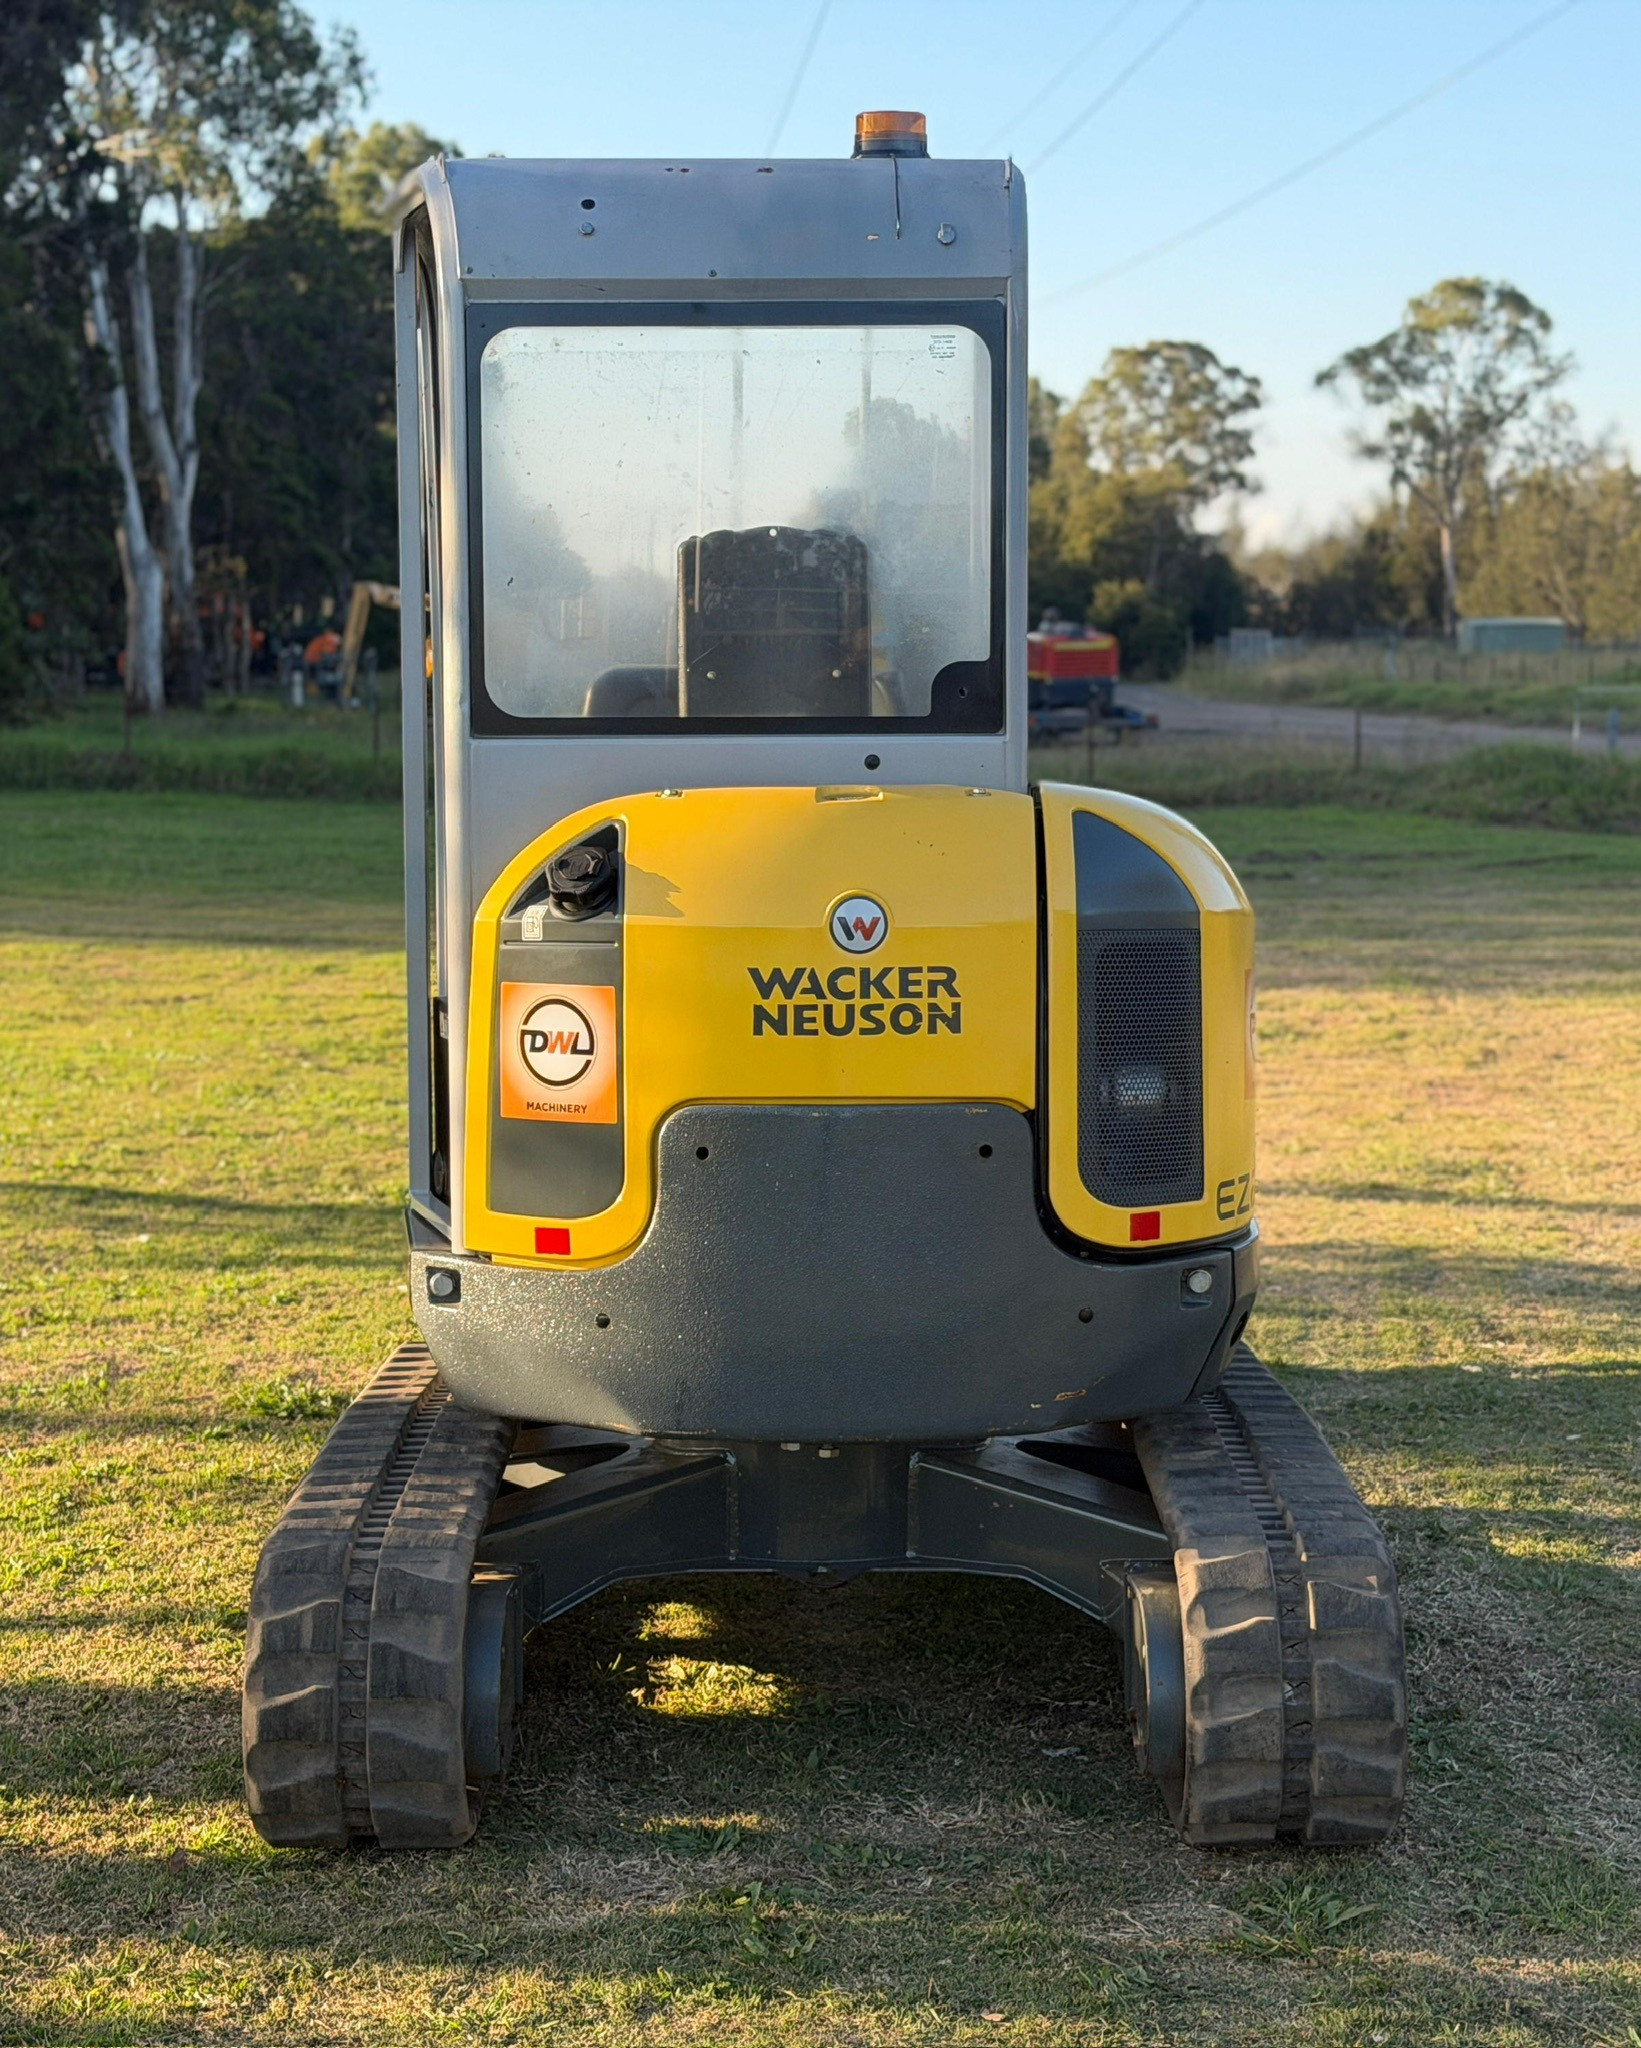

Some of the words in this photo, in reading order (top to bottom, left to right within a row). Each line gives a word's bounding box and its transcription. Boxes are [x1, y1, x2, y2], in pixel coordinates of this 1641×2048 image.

[747, 966, 962, 1000] WACKER
[752, 1002, 962, 1036] NEUSON
[520, 1029, 594, 1056] DWL
[526, 1101, 588, 1115] MACHINERY
[1216, 1172, 1254, 1221] EZ
